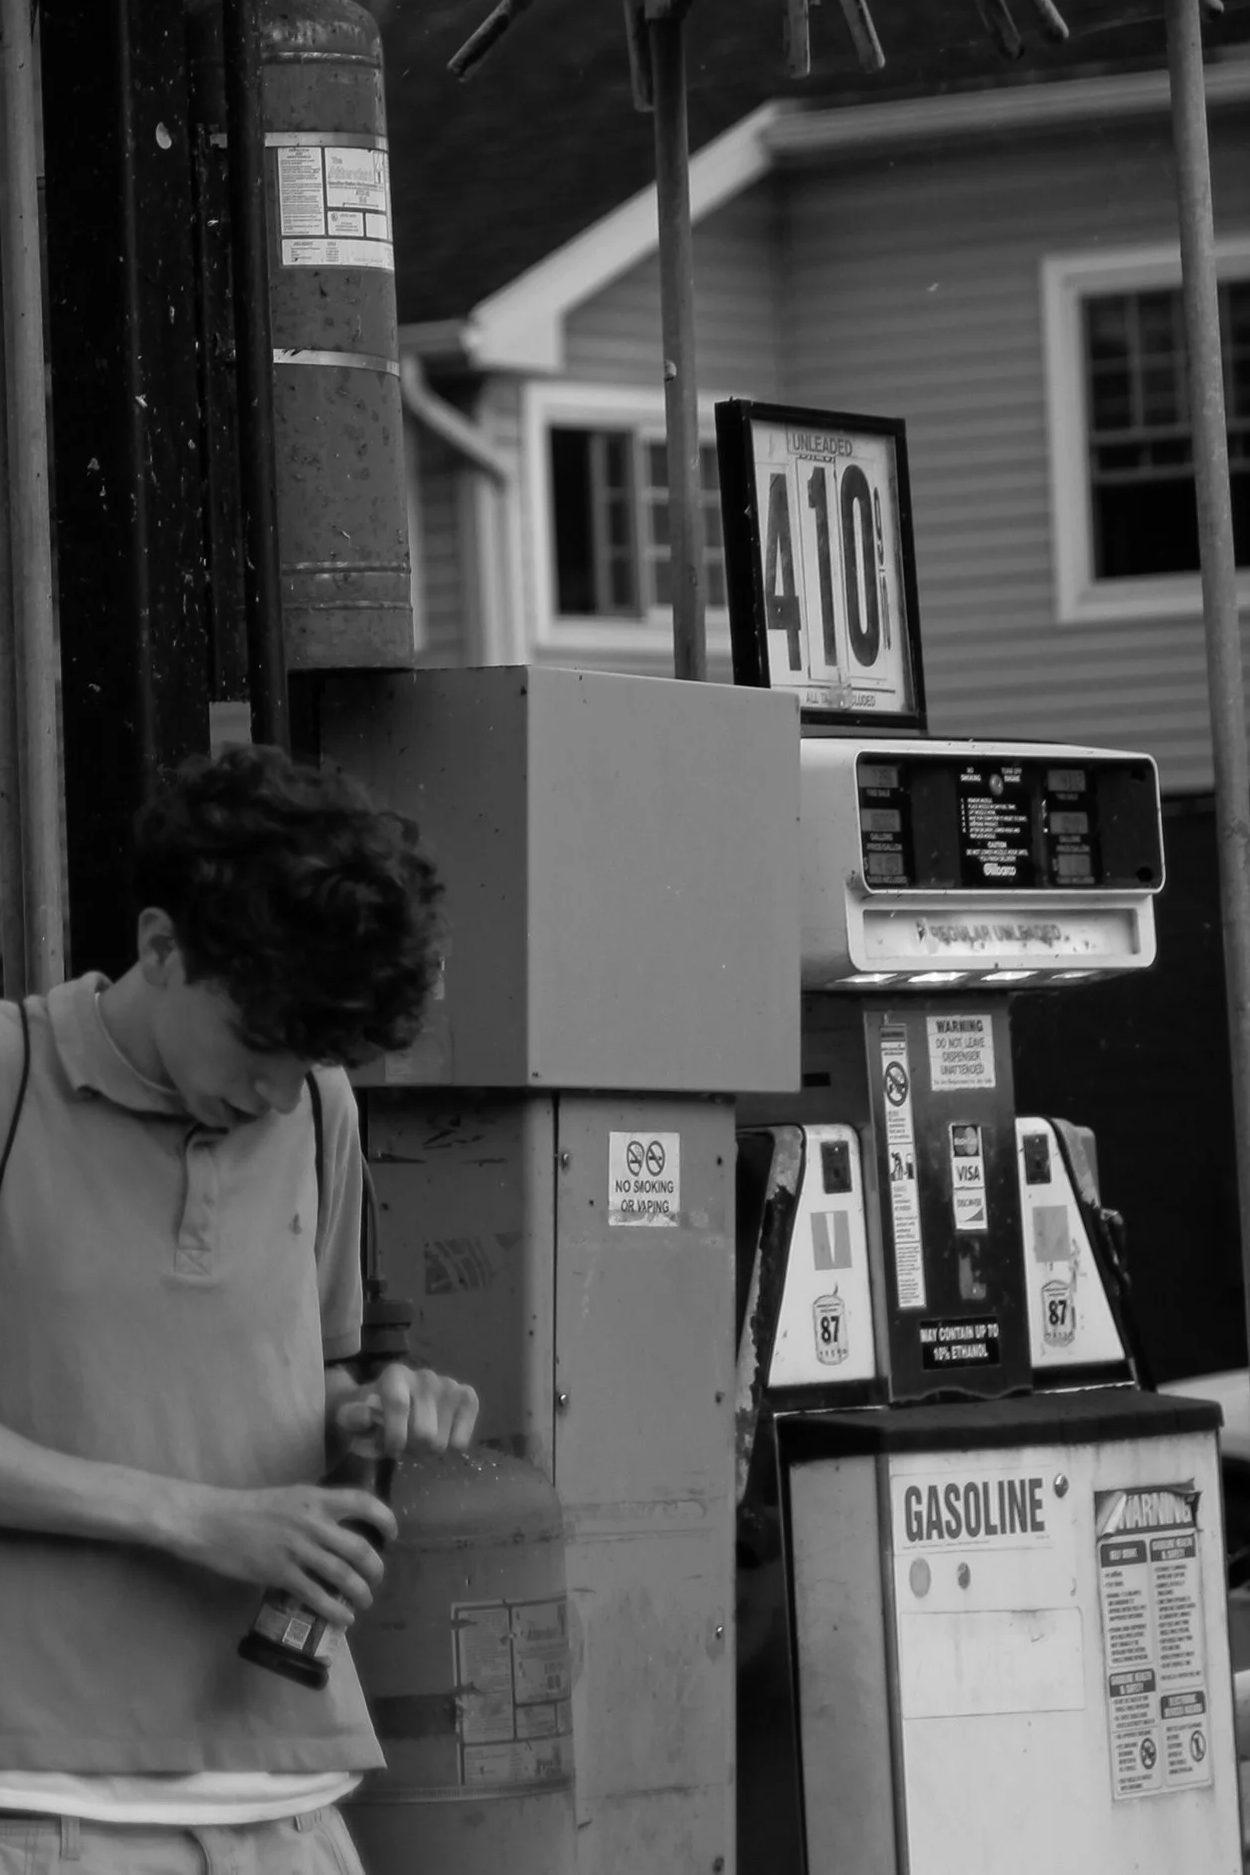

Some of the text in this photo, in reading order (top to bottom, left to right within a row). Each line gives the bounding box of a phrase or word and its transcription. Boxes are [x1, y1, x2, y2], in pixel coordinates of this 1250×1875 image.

[793, 433, 853, 457] UNLEADED
[936, 1020, 983, 1033] WARNING
[941, 1063, 985, 1075] UNATTENDED
[956, 1166, 981, 1181] VISA
[615, 1180, 631, 1193] NO
[621, 1199, 669, 1214] OR VAPING
[1049, 1300, 1067, 1325] 87
[821, 1315, 839, 1343] 87
[920, 1323, 999, 1342] MAY CONTAIN UP TO
[934, 1343, 988, 1361] 10% ETHANOL
[904, 1478, 1045, 1542] GASOLINE
